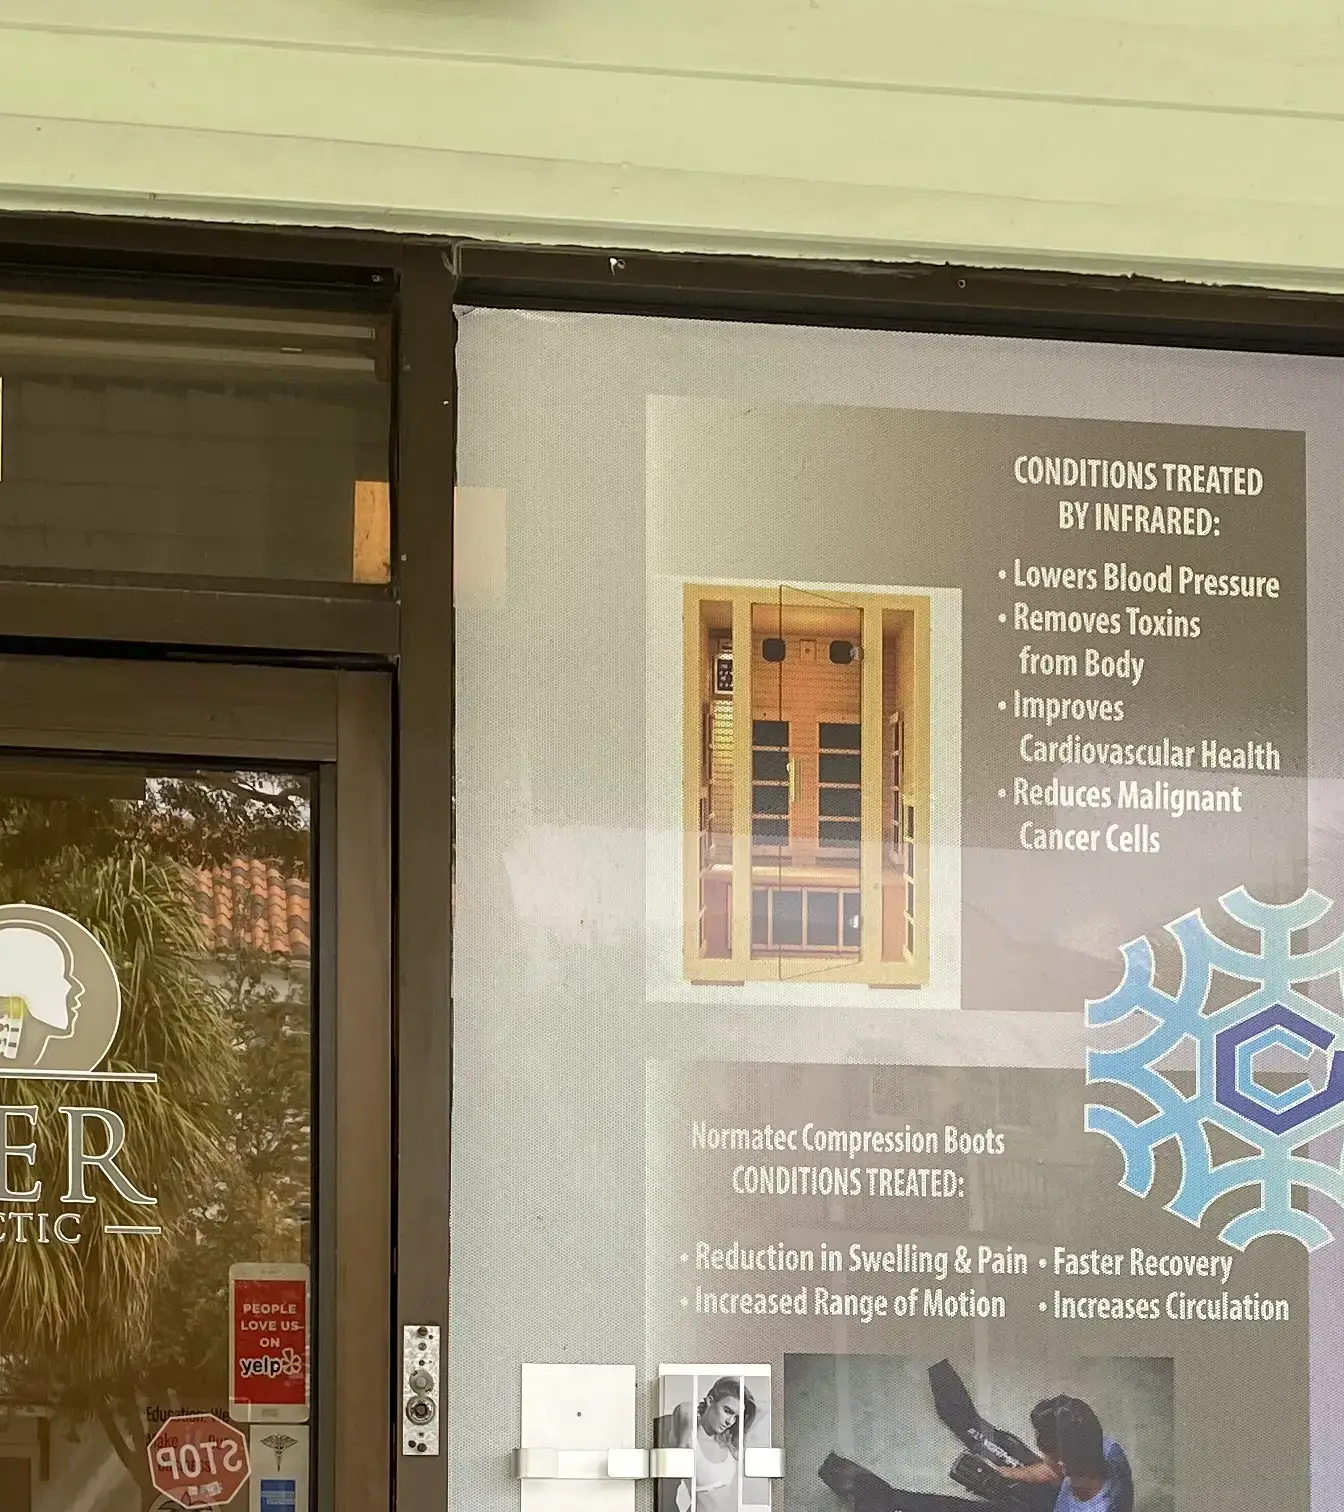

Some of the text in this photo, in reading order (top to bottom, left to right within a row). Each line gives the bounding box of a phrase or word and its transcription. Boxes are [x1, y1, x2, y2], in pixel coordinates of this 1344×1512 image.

[1014, 456, 1263, 496] CONDITIONS TREATED
[1059, 500, 1220, 537] BY INFRARED:
[1014, 559, 1280, 598] Lowers Blood Pressure
[1014, 602, 1201, 638] Removes Toxins
[1019, 645, 1144, 686] from Body
[1014, 690, 1124, 726] Improves
[1020, 734, 1281, 770] Cardiovascular Health
[1013, 777, 1242, 817] Reduces Malignant
[1020, 821, 1160, 853] Cancer Cells
[692, 1122, 1005, 1159] Normatec Compression Boots
[732, 1165, 965, 1198] CONDITIONS TREATED:
[695, 1241, 1028, 1281] Reduction Swelling Pain
[1054, 1247, 1232, 1285] Faster Recovery
[243, 1304, 296, 1315] PEOPLE
[695, 1287, 1005, 1323] Increased Range Motion
[1054, 1290, 1289, 1320] Increases Circulation
[241, 1321, 298, 1331] LOVE US
[260, 1338, 279, 1348] ON
[240, 1356, 281, 1378] yelp
